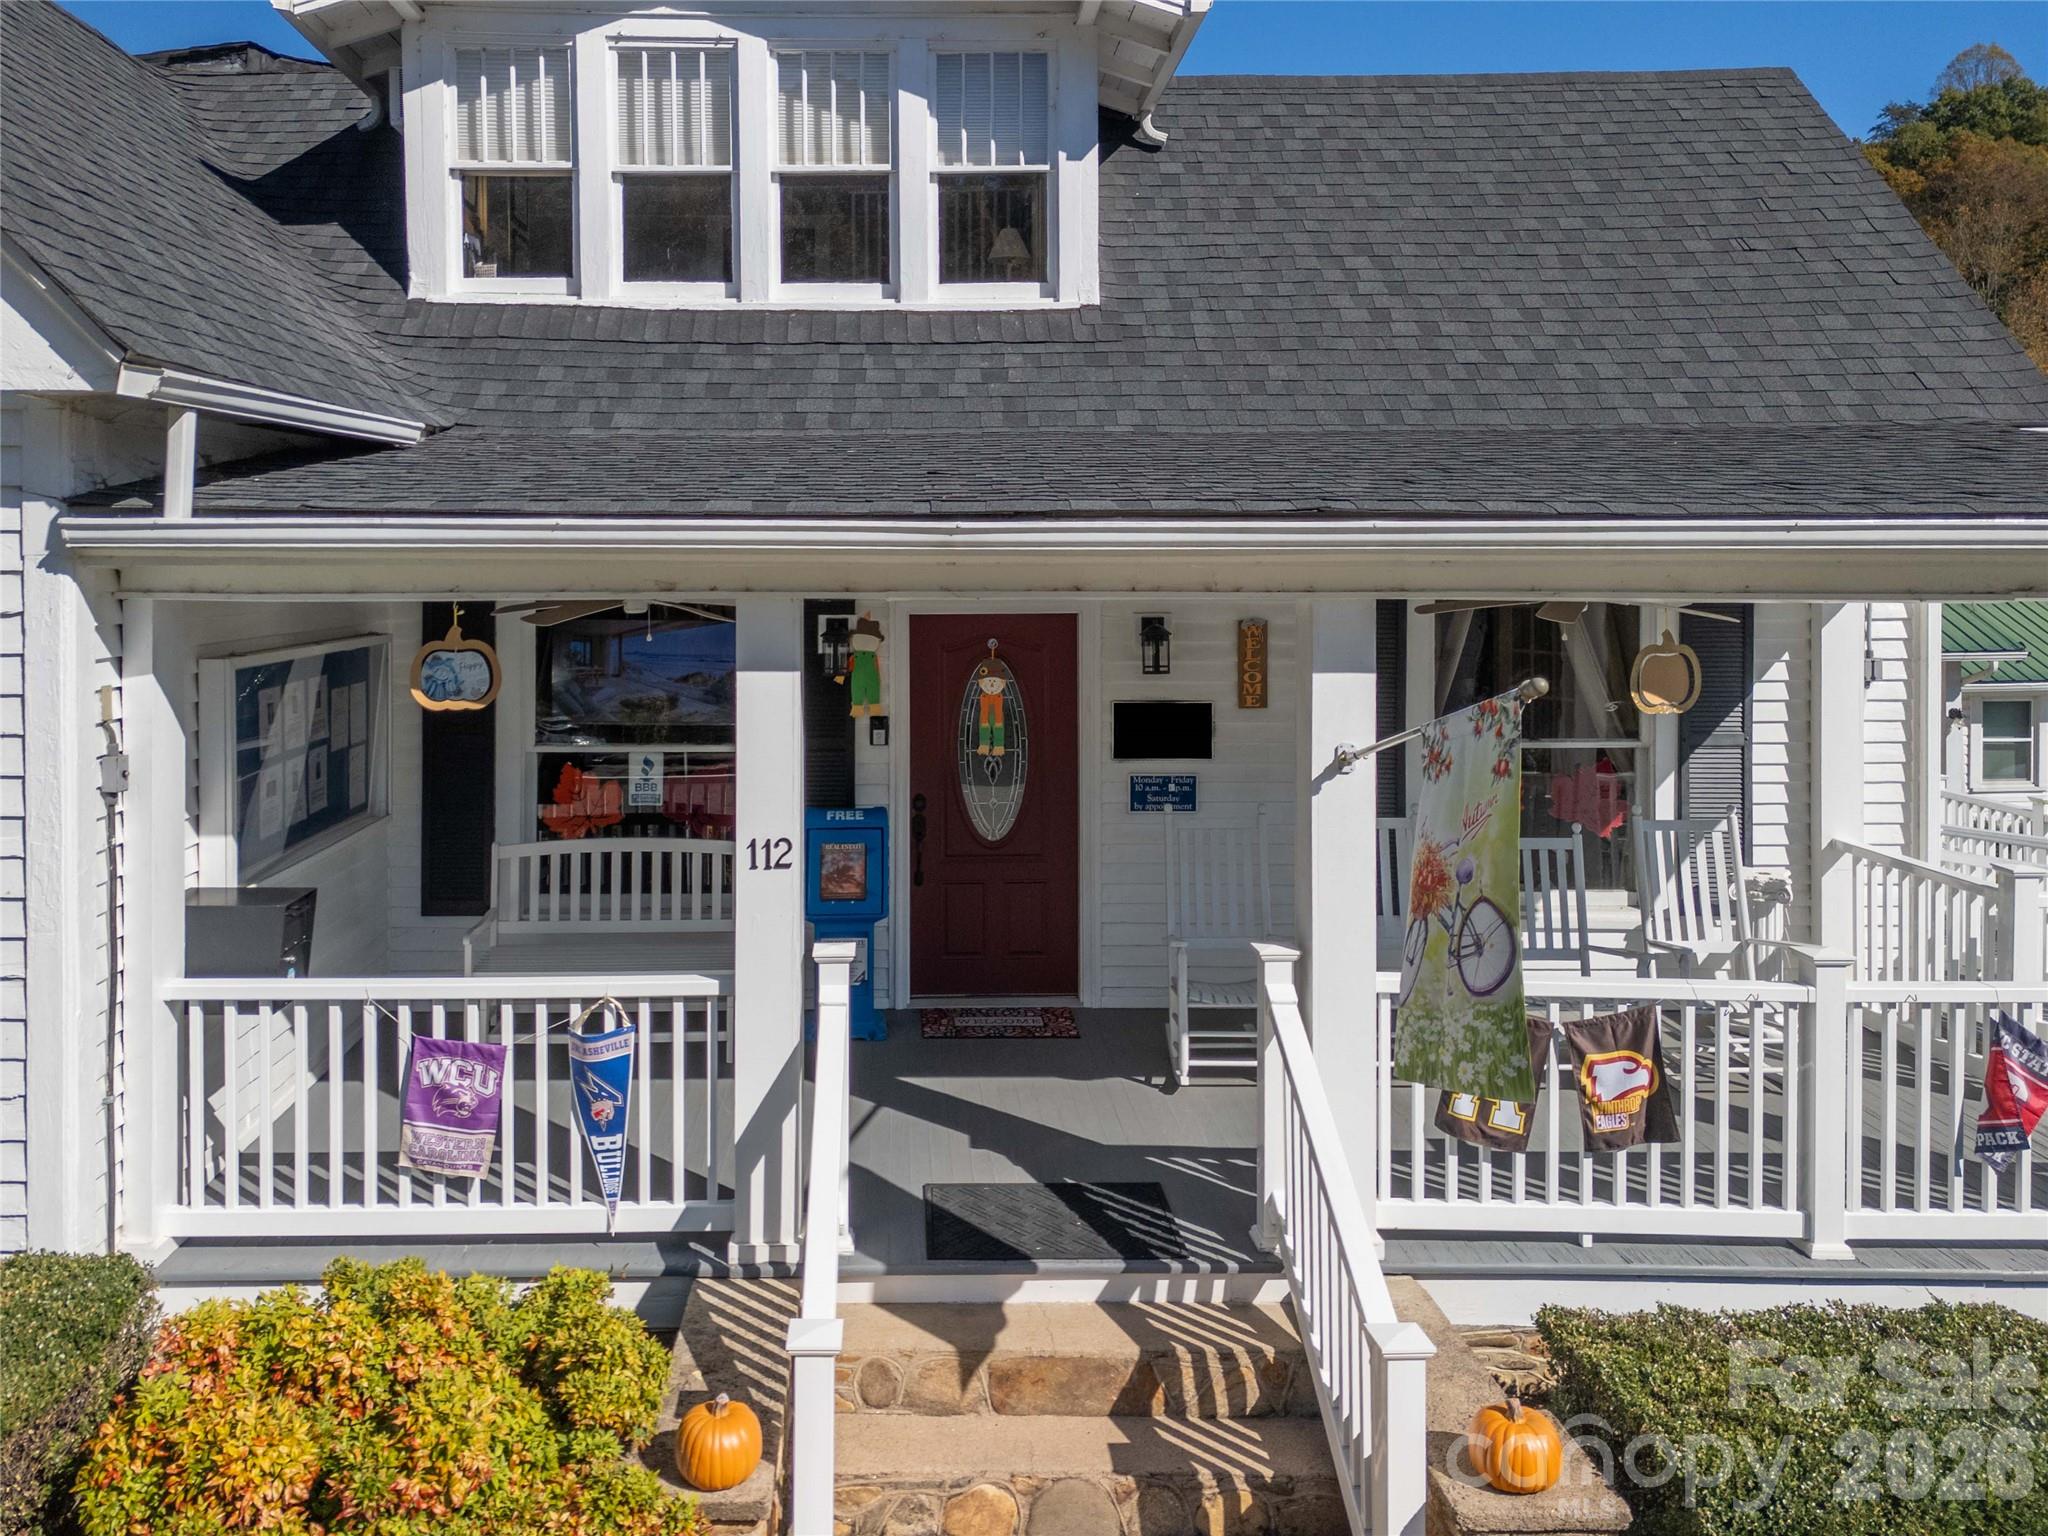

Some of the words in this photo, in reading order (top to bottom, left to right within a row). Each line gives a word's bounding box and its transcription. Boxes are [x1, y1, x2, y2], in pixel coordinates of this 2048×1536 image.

[1242, 624, 1263, 707] WELCOME
[635, 783, 657, 792] BBB
[1133, 776, 1163, 784] Monday
[1170, 776, 1194, 784] Friday
[1147, 794, 1179, 802] Saturday
[826, 811, 864, 821] FREE
[746, 838, 793, 870] 112
[583, 1038, 630, 1057] ASHEVILLE
[417, 1057, 498, 1098] WCU
[1595, 1112, 1628, 1130] EAGLES
[411, 1129, 487, 1150] WESTERN
[1976, 1131, 2021, 1147] PACK
[408, 1143, 485, 1163] CAROLINA
